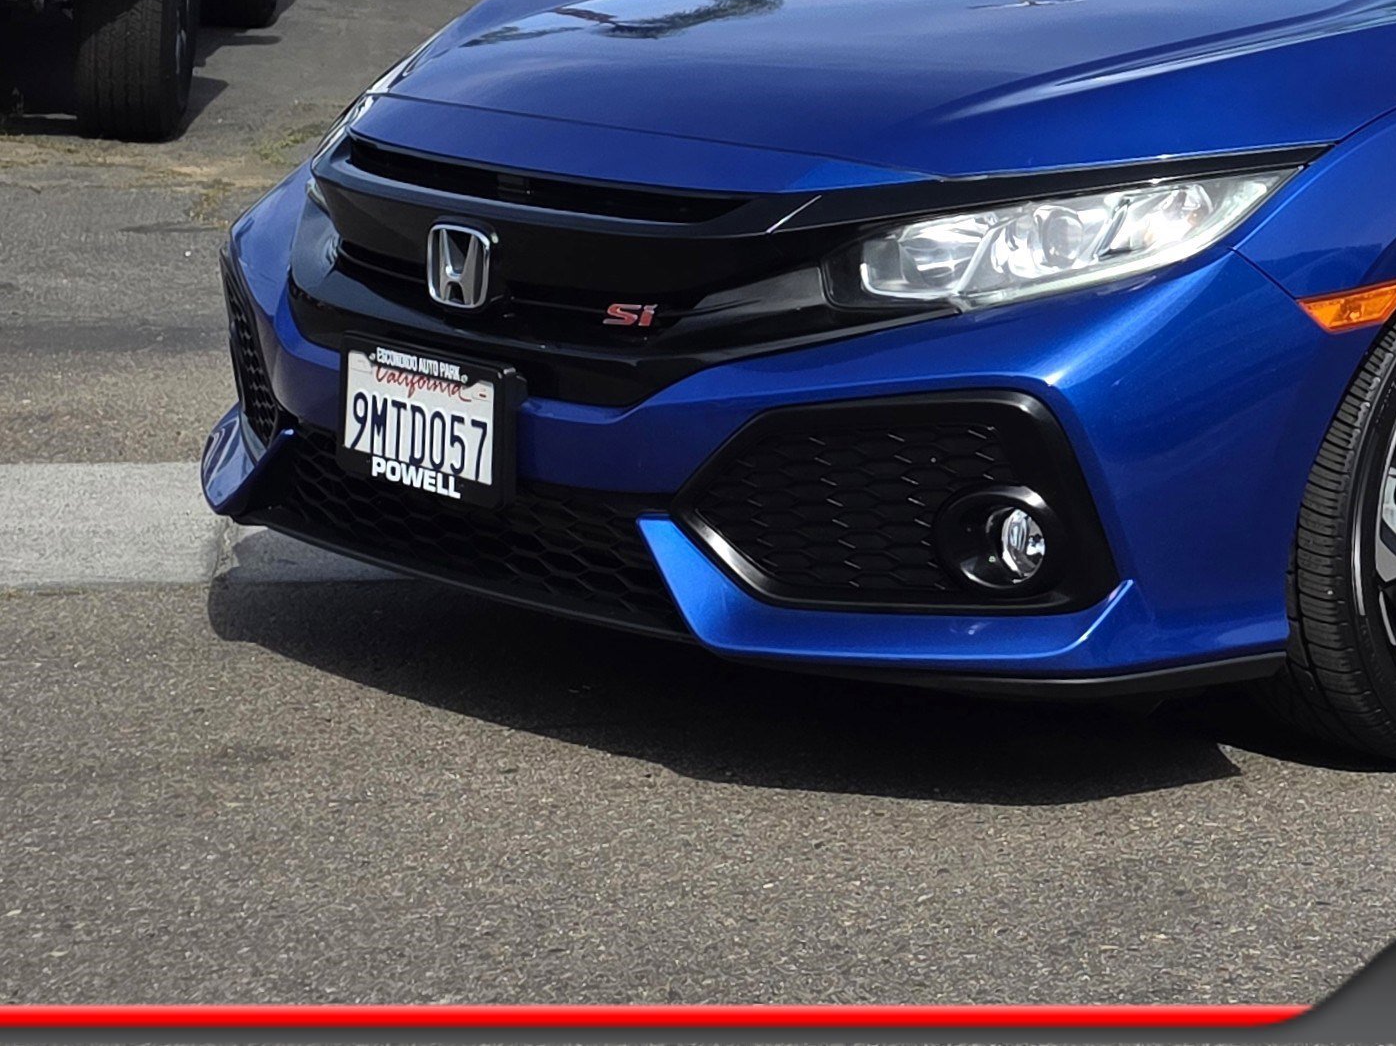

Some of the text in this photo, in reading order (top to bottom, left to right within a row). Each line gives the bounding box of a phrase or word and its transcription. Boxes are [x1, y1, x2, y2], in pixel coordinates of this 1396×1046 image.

[602, 304, 658, 327] Si
[375, 365, 472, 402] California
[418, 358, 439, 377] AUTO
[440, 362, 461, 382] PARK
[352, 391, 488, 481] 9MTD057
[371, 456, 461, 499] POWELL
